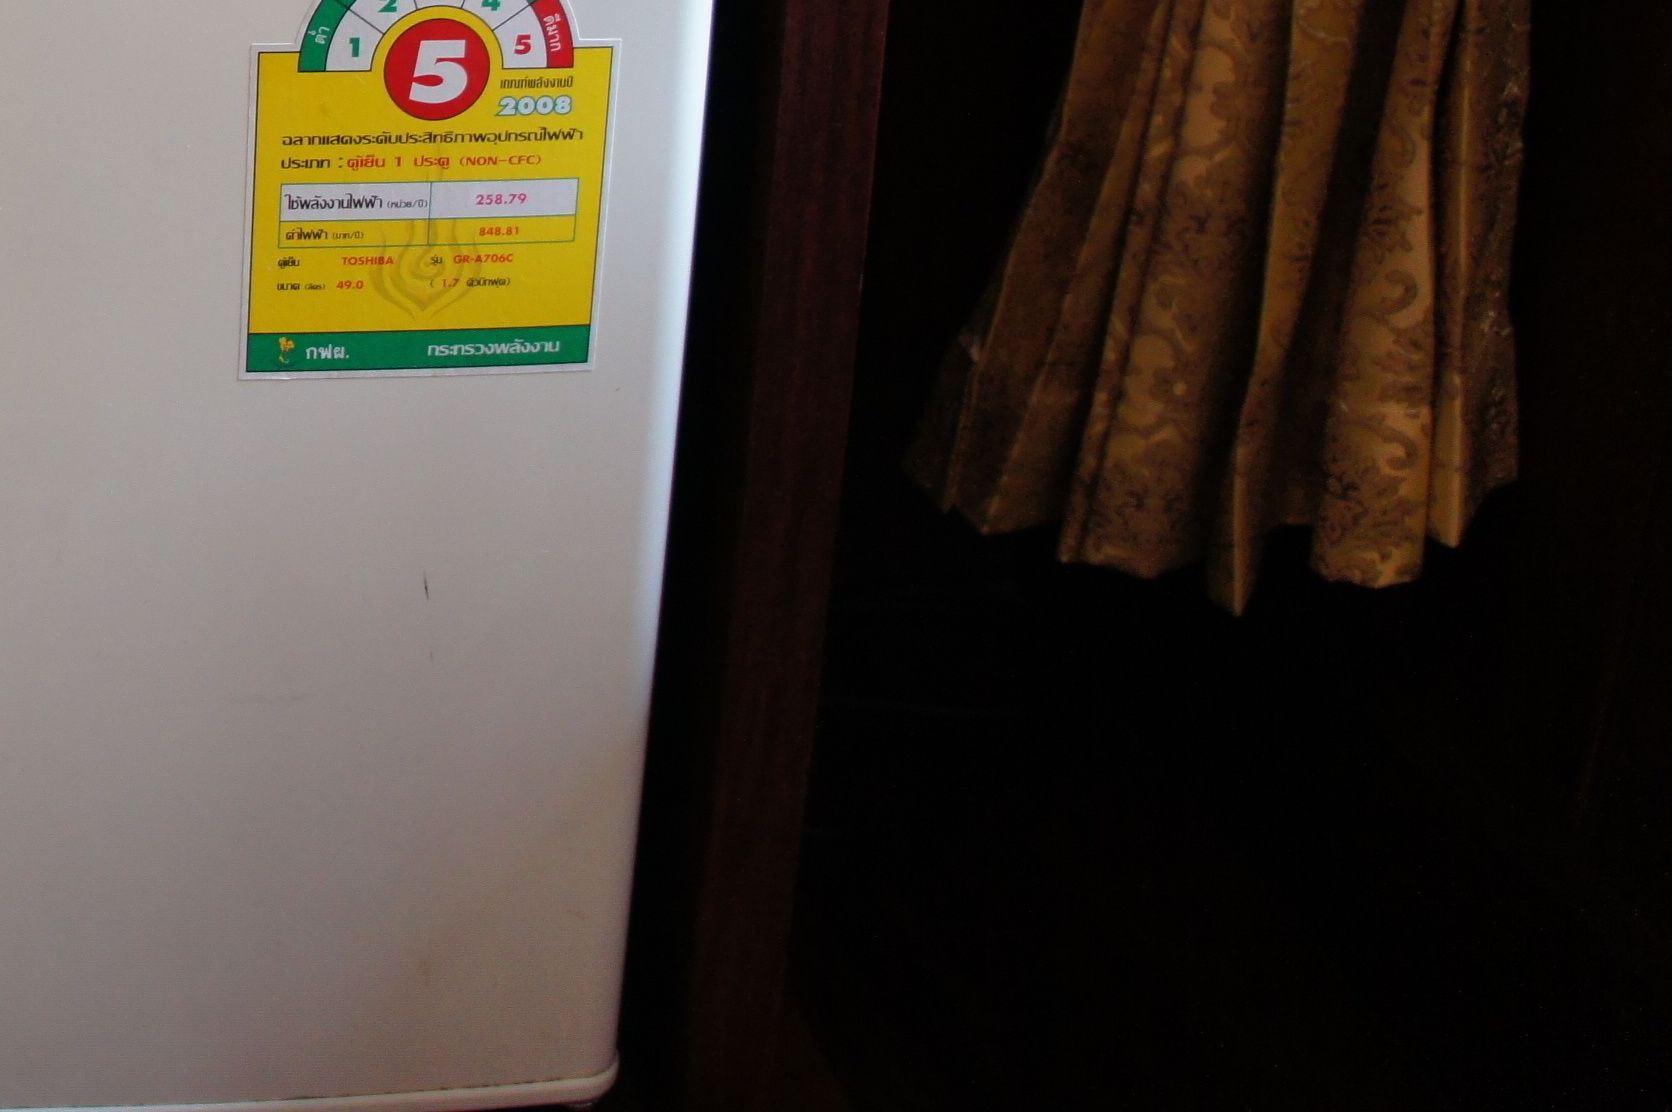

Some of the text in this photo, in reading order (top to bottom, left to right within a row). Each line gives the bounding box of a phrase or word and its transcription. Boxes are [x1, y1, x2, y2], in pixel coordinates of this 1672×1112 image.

[543, 13, 562, 52] ดีมาก
[349, 37, 361, 58] 1
[513, 34, 533, 56] 5
[408, 39, 468, 104] 5
[495, 94, 573, 117] 2008
[394, 155, 403, 168] 1
[459, 154, 542, 167] (NON-CFC)
[475, 192, 528, 206] 258.79
[478, 226, 521, 237] 848.81
[341, 255, 395, 266] TOSHIBA
[453, 253, 515, 265] GR-A706C
[336, 279, 365, 290] 49.0
[441, 278, 461, 288] 1.7
[305, 338, 561, 360] กฟผ. กระทรวงพลังงาน
